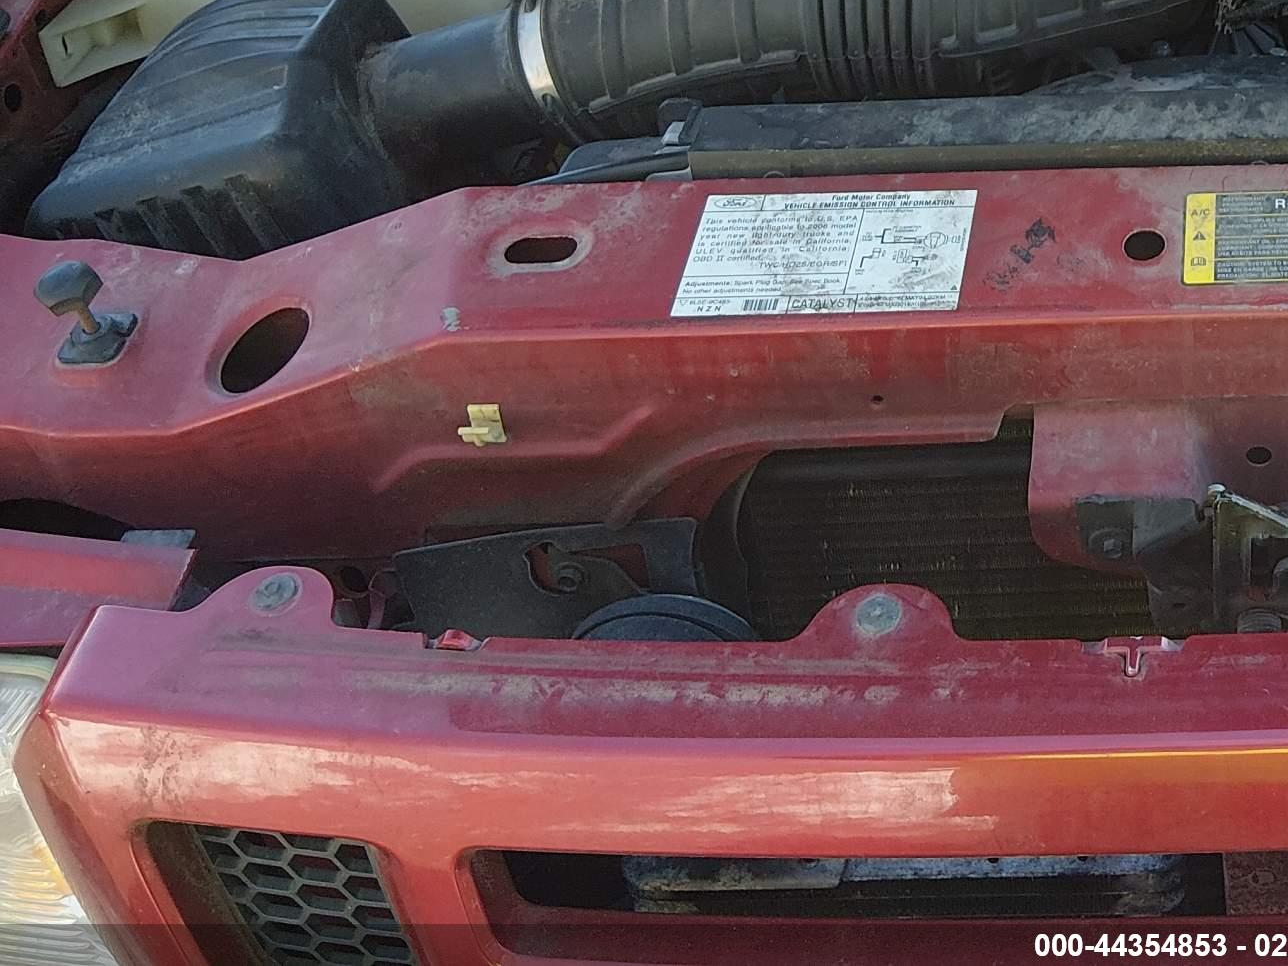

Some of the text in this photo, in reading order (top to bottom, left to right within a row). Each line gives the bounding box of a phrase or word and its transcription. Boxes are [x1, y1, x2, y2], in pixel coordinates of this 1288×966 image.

[853, 193, 874, 201] Motor
[875, 192, 911, 202] Company
[784, 198, 956, 210] VEHICLE EMISSION CONTROL INFORMATION
[791, 297, 855, 310] CATALYST
